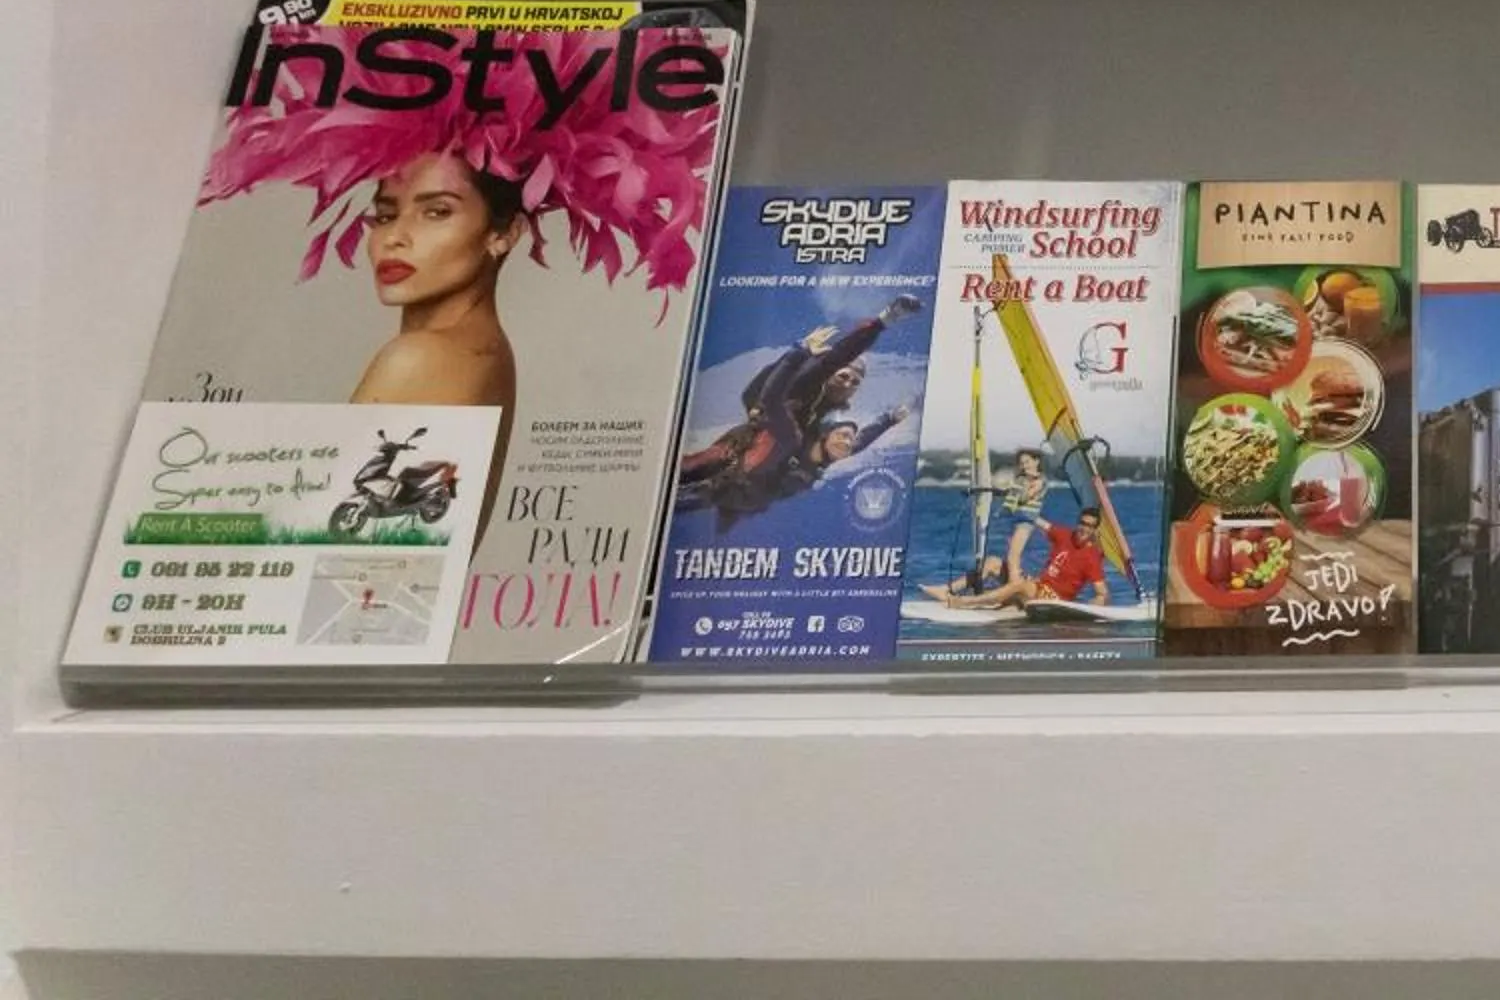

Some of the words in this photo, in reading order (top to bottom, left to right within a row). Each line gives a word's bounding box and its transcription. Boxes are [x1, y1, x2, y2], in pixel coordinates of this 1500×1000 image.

[342, 2, 462, 19] EKSKLUZIVNO
[465, 6, 506, 20] PRVI
[509, 7, 522, 20] U
[524, 6, 625, 21] HRVATSKOJ
[227, 26, 727, 131] InStyle
[762, 199, 912, 223] SKYDIVE
[959, 198, 1163, 237] Windsurfing
[1214, 200, 1387, 226] PIANTINA
[781, 223, 887, 246] ADRIA
[964, 233, 1023, 243] CAMPING
[1029, 230, 1139, 260] School
[796, 247, 867, 264] ISTRA
[720, 275, 777, 287] LOOKING
[780, 275, 805, 287] FOR
[820, 275, 851, 287] NEW
[960, 273, 1038, 302] Rent
[1043, 280, 1063, 302] a
[1071, 273, 1150, 302] Boat
[310, 446, 340, 460] are
[142, 518, 175, 532] Rent
[179, 518, 191, 532] A
[195, 517, 256, 533] Scooter
[674, 547, 779, 580] TANDEM
[793, 546, 903, 579] SKYDIVE
[1304, 562, 1359, 593] JEDI
[1265, 583, 1397, 632] ZDRAVO!
[741, 617, 796, 630] SKYDIVE
